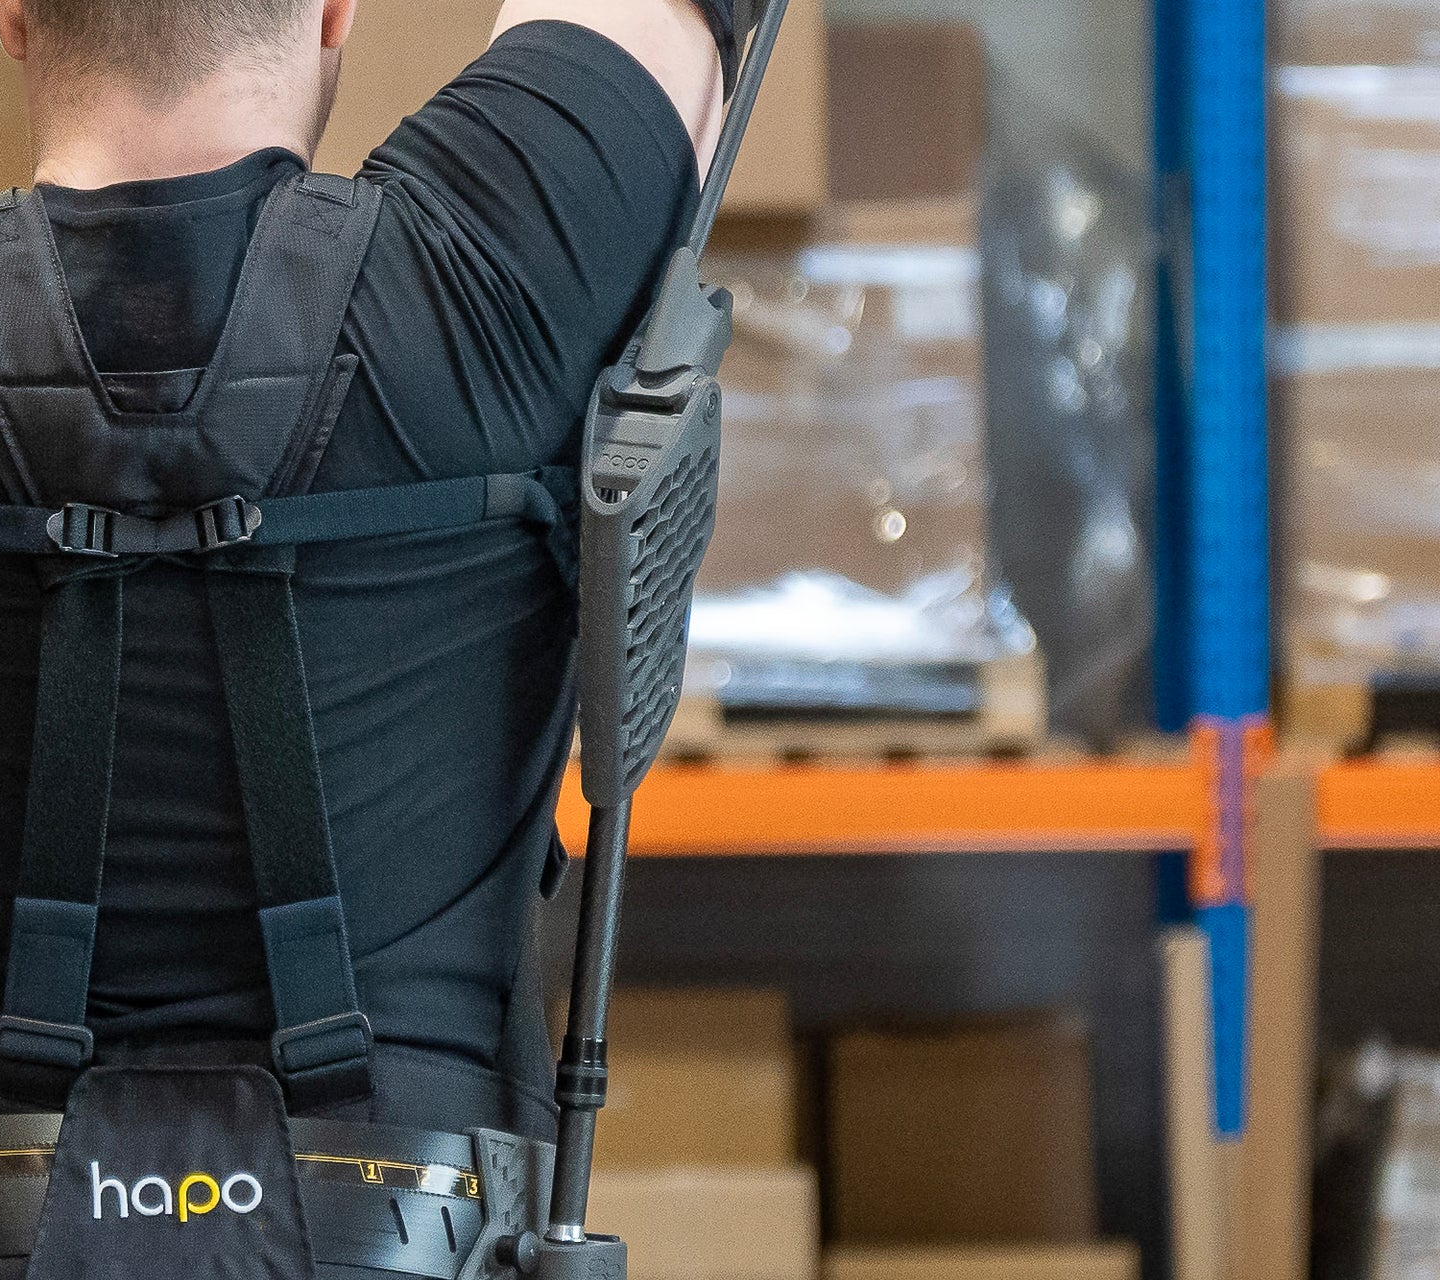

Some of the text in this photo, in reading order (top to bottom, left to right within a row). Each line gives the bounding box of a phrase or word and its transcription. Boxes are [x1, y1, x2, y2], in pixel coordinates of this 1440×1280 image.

[90, 1160, 263, 1223] hapo
[367, 1163, 379, 1180] 1
[468, 1178, 479, 1195] 3
